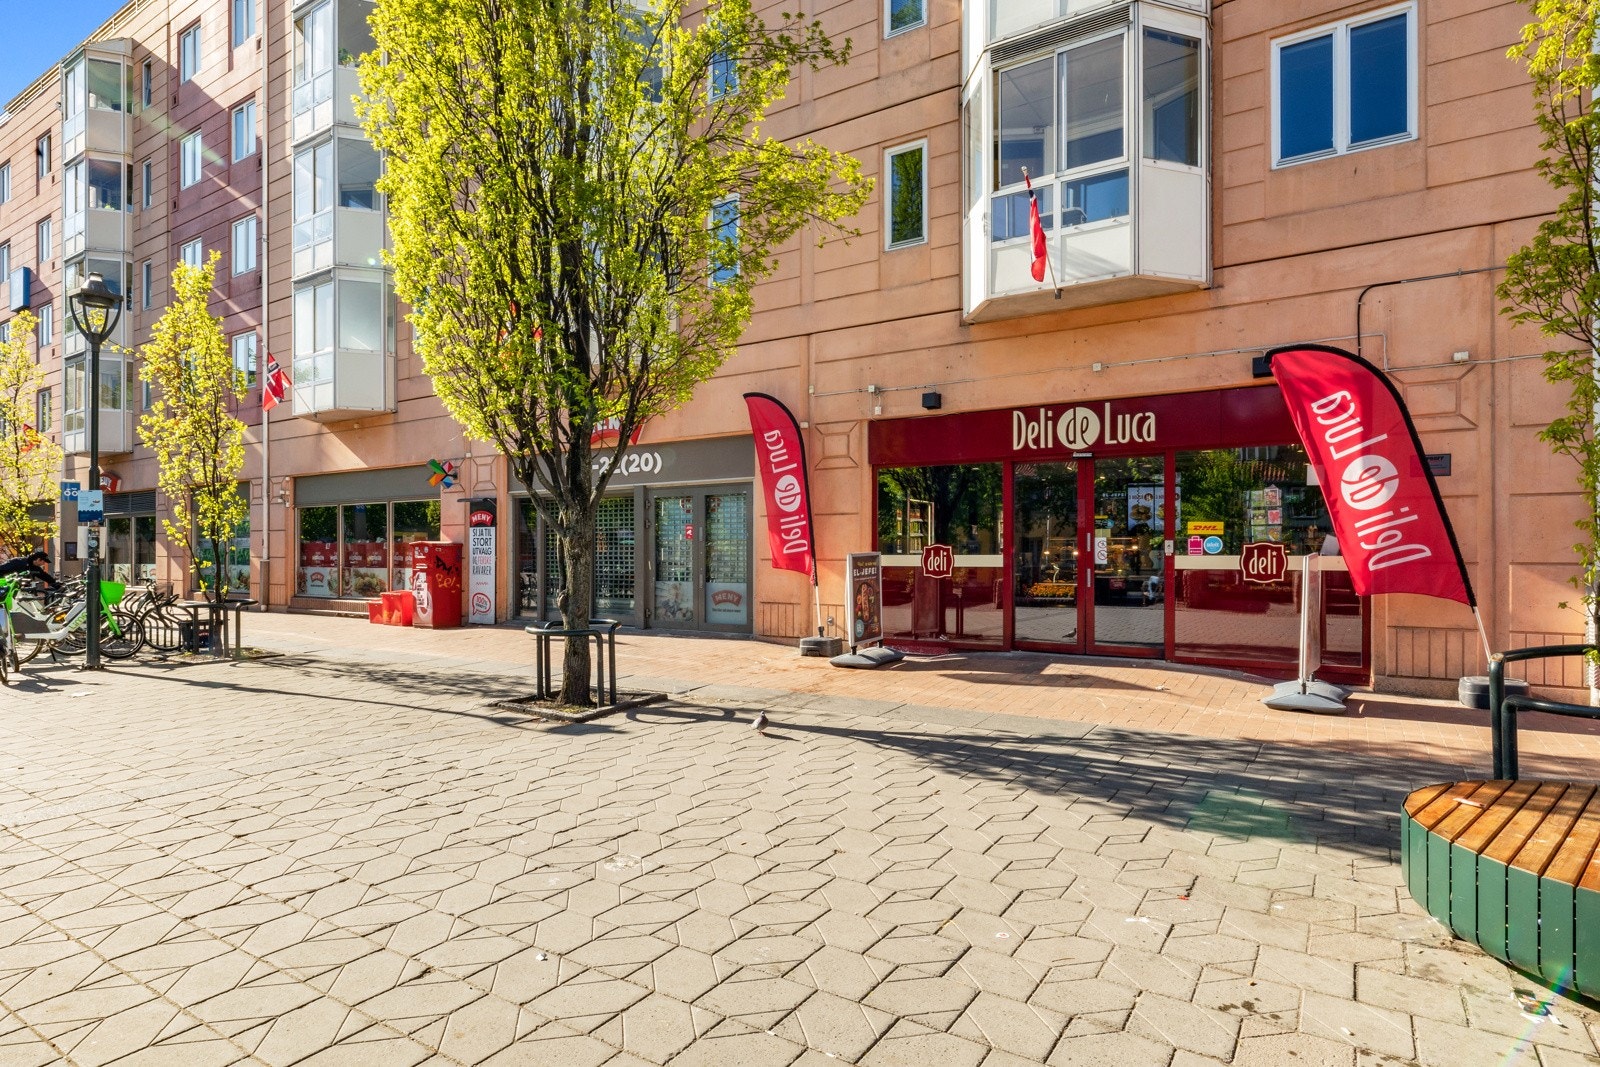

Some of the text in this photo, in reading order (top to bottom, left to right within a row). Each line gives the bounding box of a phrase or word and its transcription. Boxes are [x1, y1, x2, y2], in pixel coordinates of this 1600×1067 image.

[1012, 402, 1156, 451] Deli de Luca
[471, 513, 491, 523] MENY
[472, 538, 492, 547] STORT
[927, 550, 947, 571] deli
[1248, 549, 1277, 575] deli
[714, 592, 739, 602] MENY
